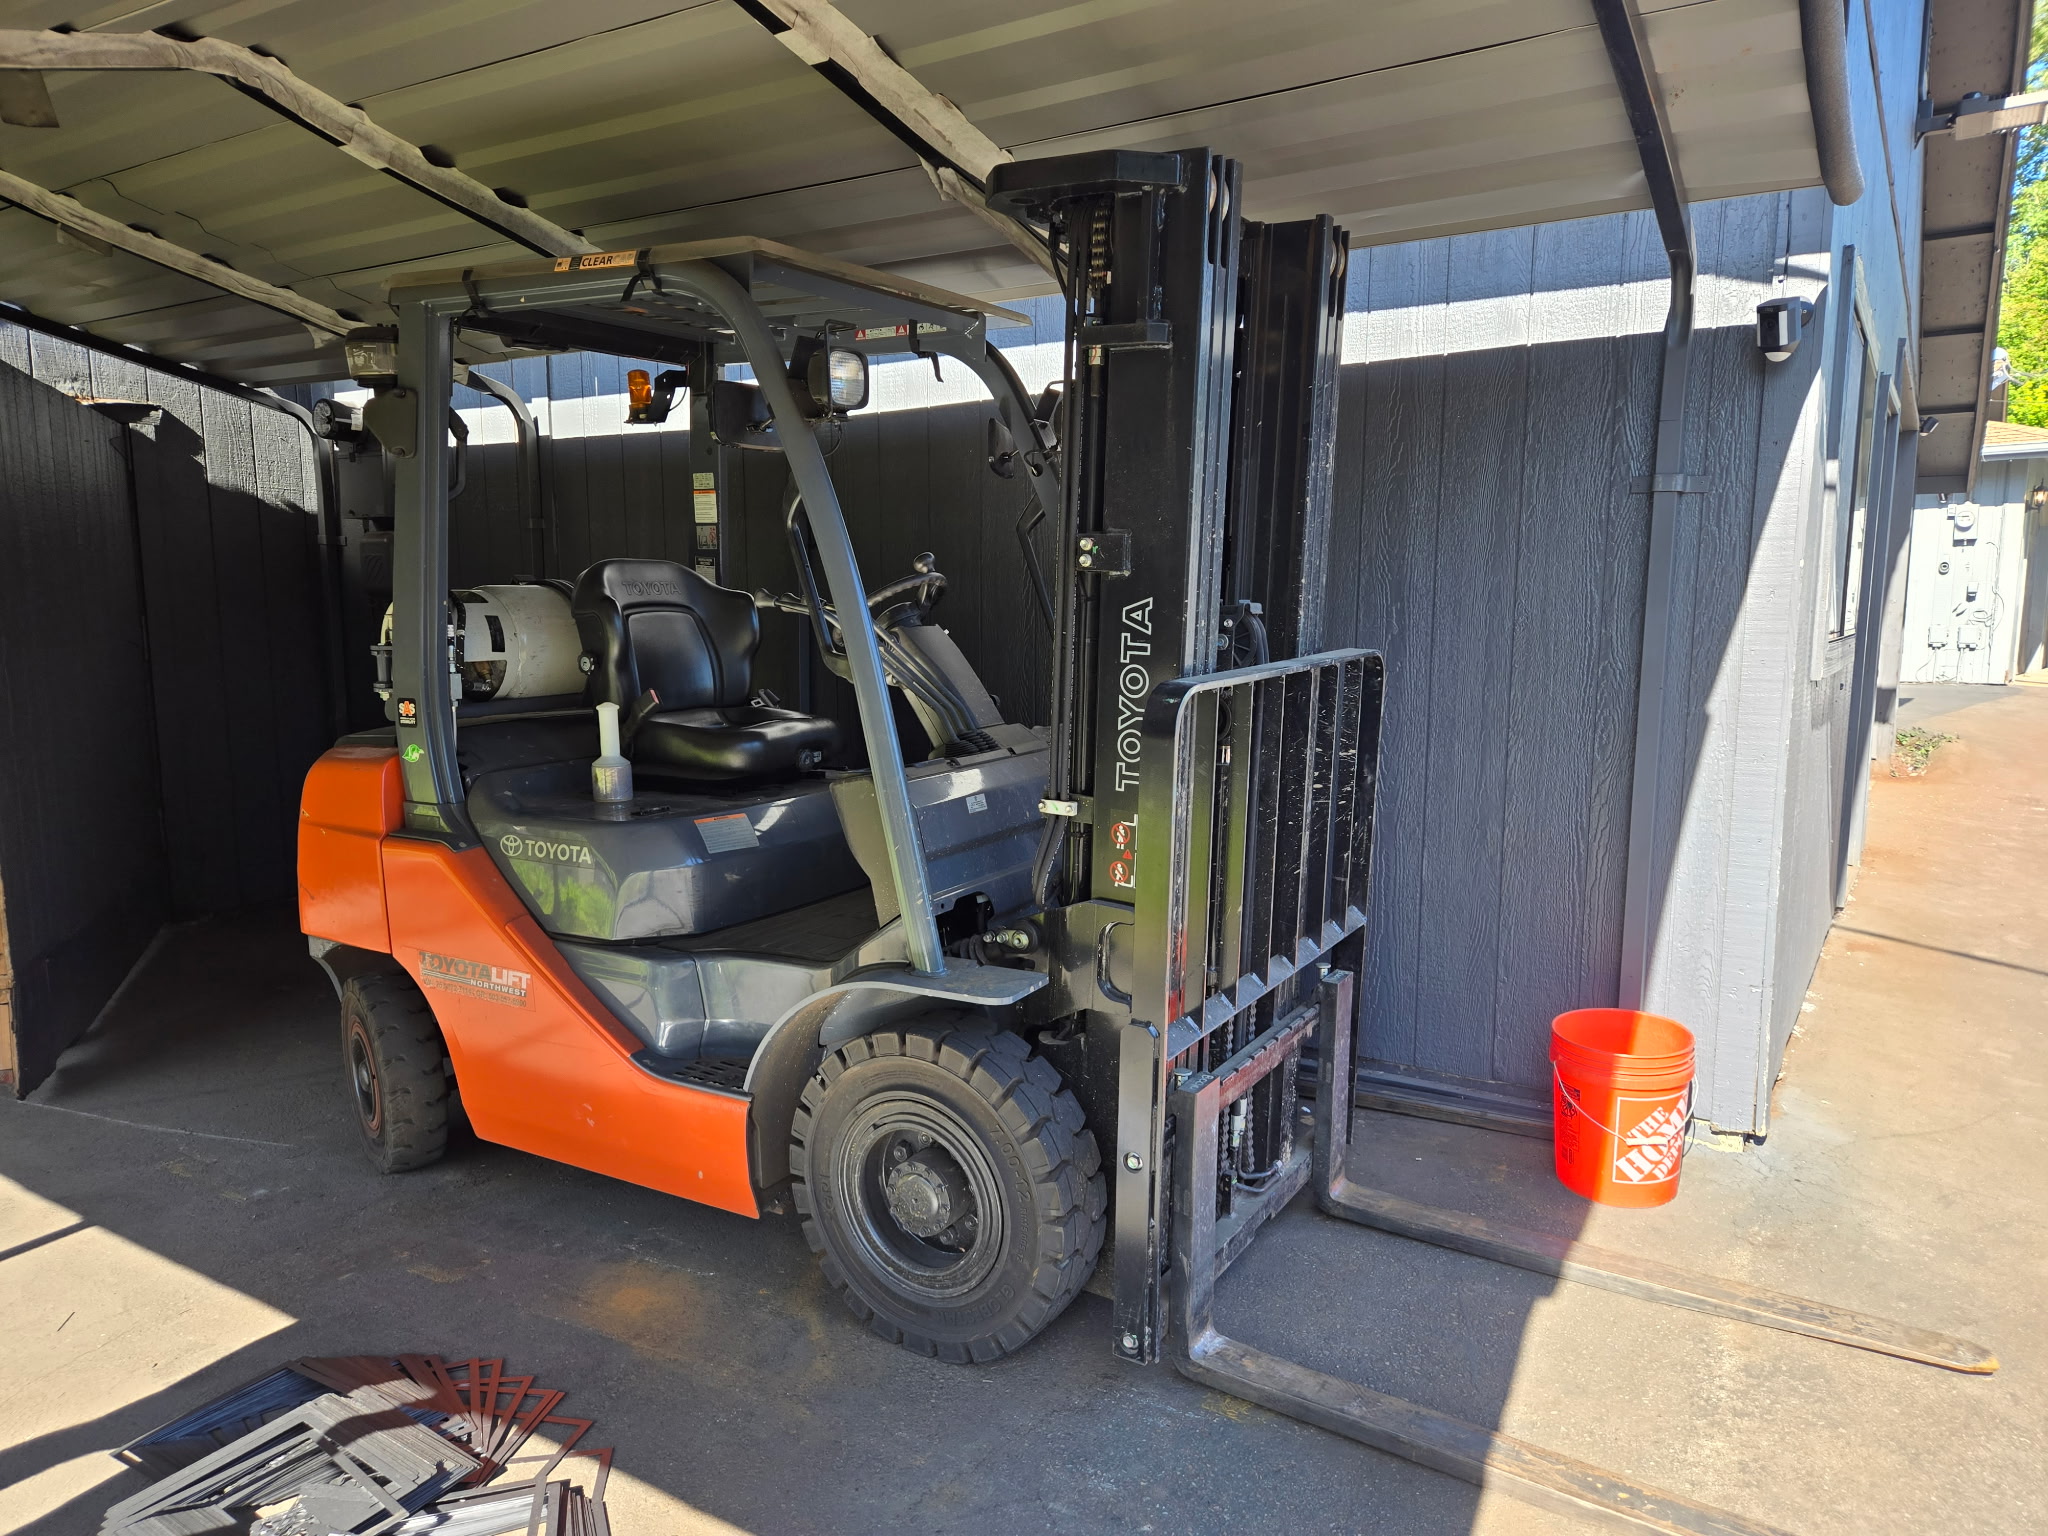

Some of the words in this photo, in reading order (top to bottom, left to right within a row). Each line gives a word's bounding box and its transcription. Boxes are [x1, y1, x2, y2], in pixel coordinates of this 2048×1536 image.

[621, 581, 682, 596] TOYOTA
[1115, 597, 1153, 792] TOYOTA
[398, 700, 416, 717] SAS
[525, 839, 592, 865] TOYOTA
[470, 978, 527, 998] NORTHWEST
[1626, 1106, 1669, 1139] THE
[990, 1123, 1032, 1204] 7.00-12
